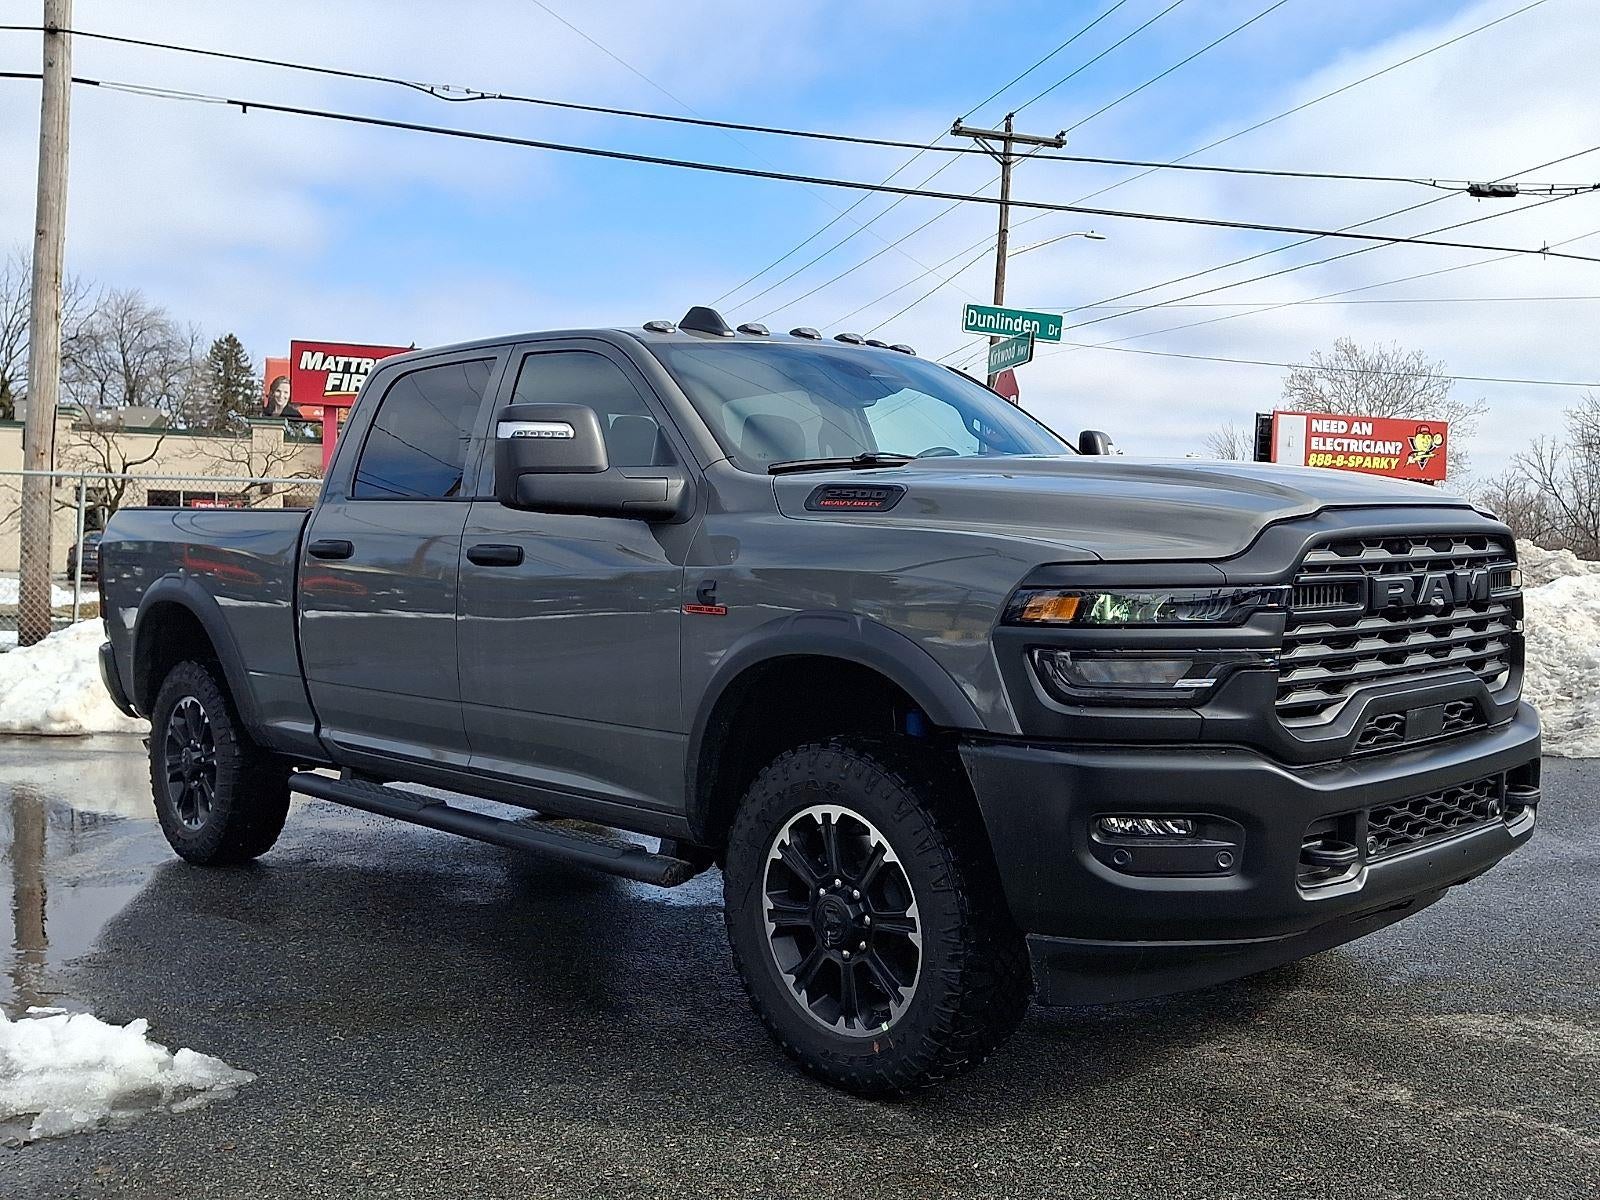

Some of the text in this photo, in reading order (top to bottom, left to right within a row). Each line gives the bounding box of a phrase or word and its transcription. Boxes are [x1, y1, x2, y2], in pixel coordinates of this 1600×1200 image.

[967, 309, 1060, 337] Dunlinden Dr
[990, 342, 1016, 366] Kirkwood
[1311, 419, 1373, 435] NEED AN
[1310, 437, 1403, 455] ELECTRICIAN?
[1308, 453, 1400, 470] 888-8-SPARKY
[826, 488, 888, 499] 2500
[1372, 568, 1490, 610] RAM
